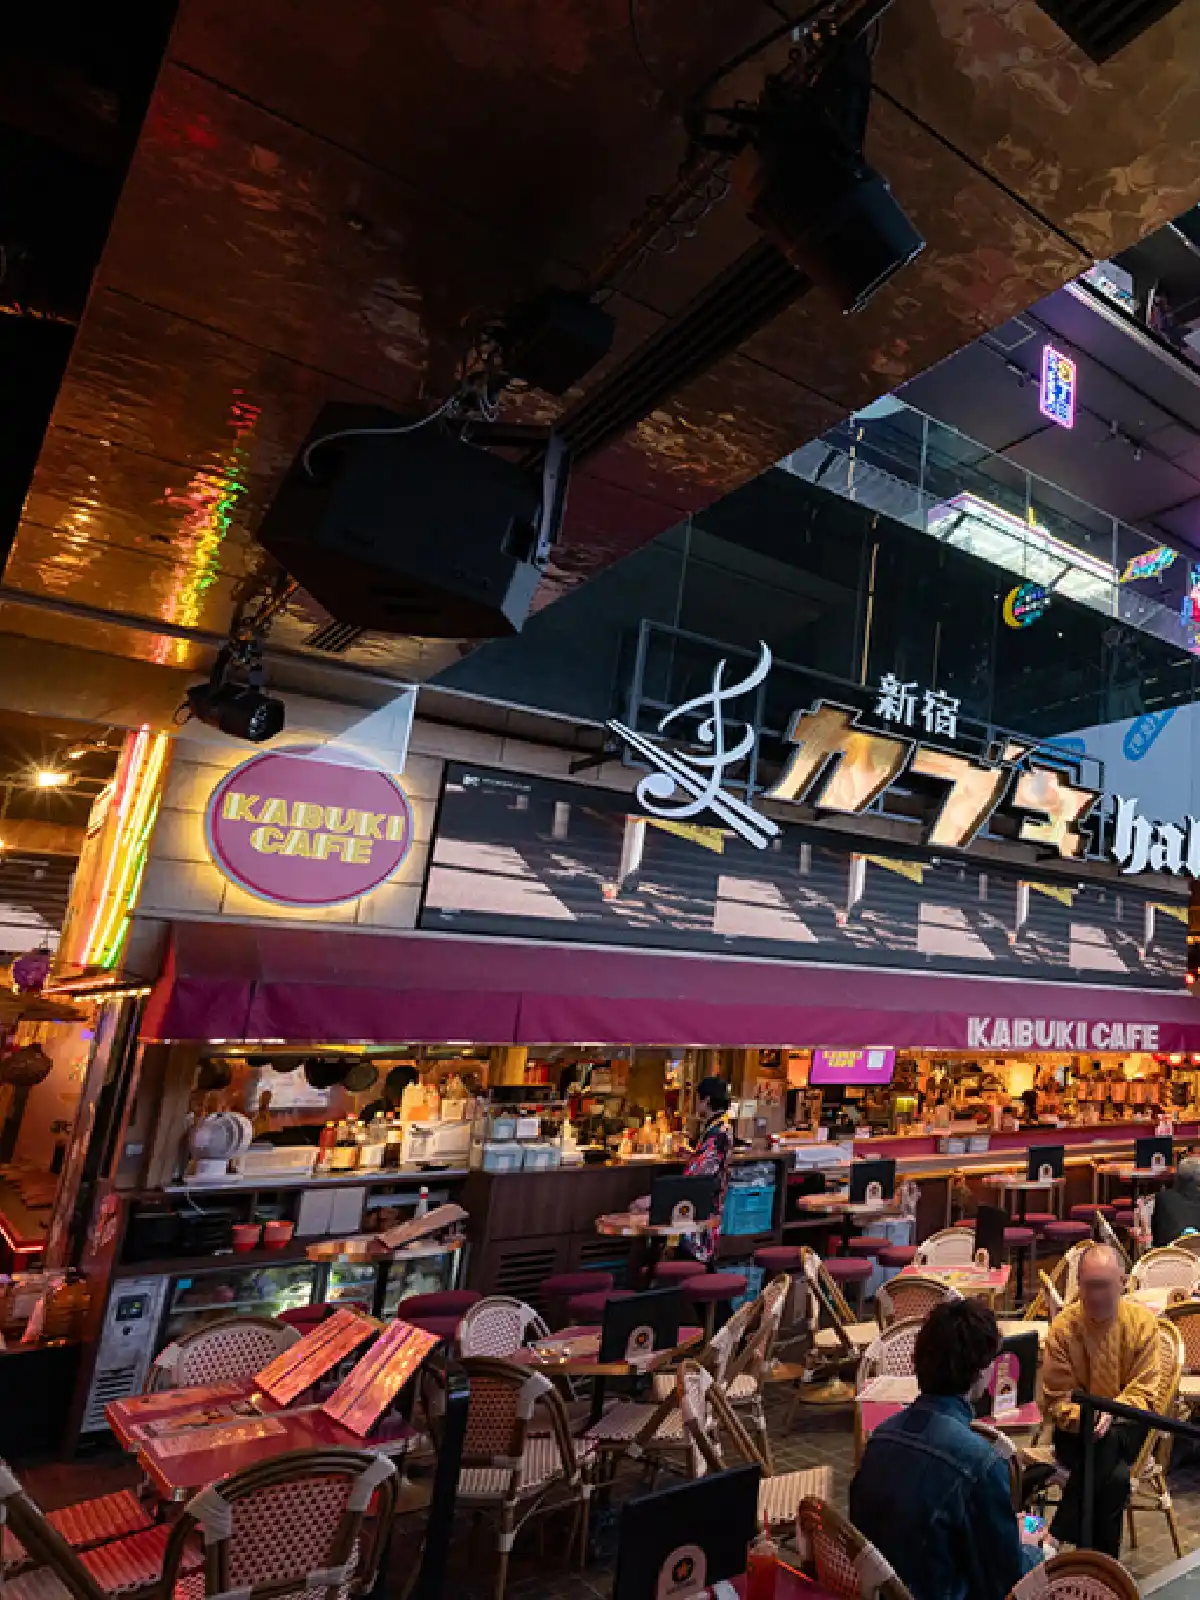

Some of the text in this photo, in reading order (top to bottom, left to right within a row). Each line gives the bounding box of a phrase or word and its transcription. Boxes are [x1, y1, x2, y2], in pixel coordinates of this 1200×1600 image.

[874, 673, 961, 739] 新宿
[222, 792, 406, 842] KABUKI
[250, 826, 375, 864] CAFE
[967, 1016, 1159, 1050] KABUKI CAFE
